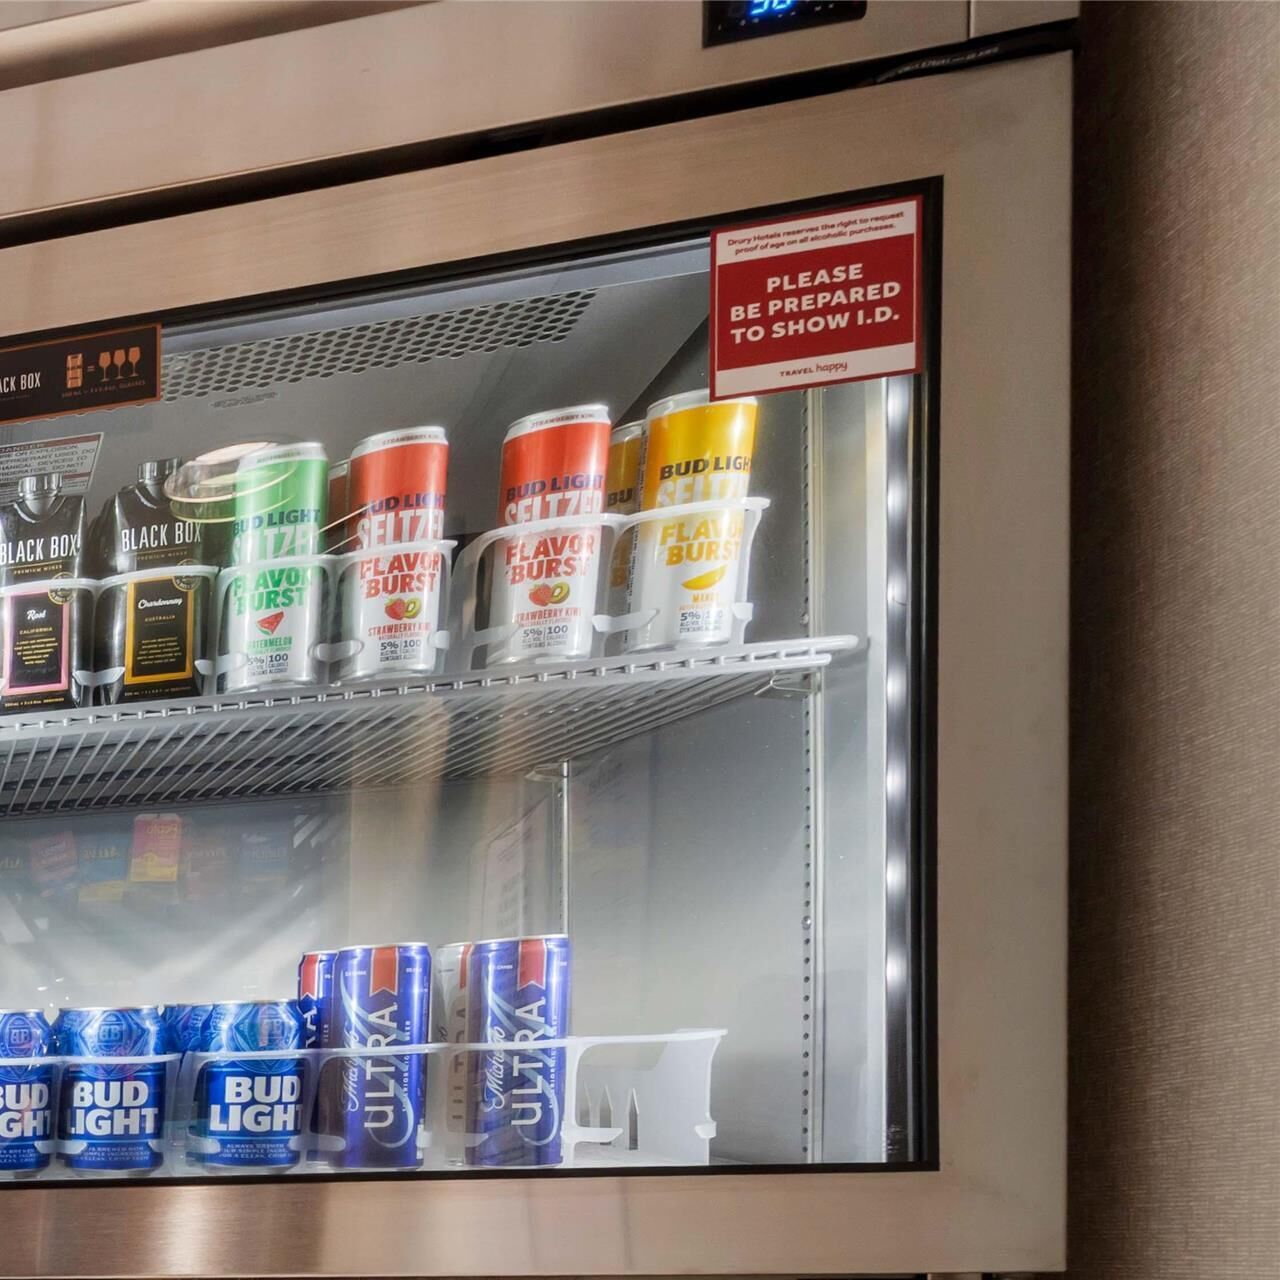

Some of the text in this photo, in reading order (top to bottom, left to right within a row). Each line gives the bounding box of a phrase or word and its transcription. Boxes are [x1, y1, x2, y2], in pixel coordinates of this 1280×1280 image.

[728, 211, 905, 248] Drury Hotels reserves the right to request
[734, 223, 896, 256] proof of age on all alcoholic purchases.
[766, 263, 864, 293] PLEASE
[730, 281, 902, 322] BE PREPARED
[730, 306, 900, 344] TO SHOW I.D.
[20, 371, 42, 391] BOX
[779, 361, 848, 378] TRAVEL happy
[659, 459, 708, 481] BUD
[507, 474, 604, 500] BUD LIGHT
[267, 509, 321, 527] LIGHT
[0, 533, 78, 566] BLACK BOX
[121, 521, 202, 552] BLACK BOX
[506, 534, 595, 566] FLAVOR
[665, 541, 740, 566] BURST
[13, 566, 42, 575] PREMIUM
[360, 552, 443, 579] FLAVOR
[510, 556, 589, 585] BURST
[365, 573, 437, 599] BURST
[137, 597, 183, 610] Chardonnay
[19, 626, 53, 635] CALIFORNIA
[144, 614, 176, 623] AUSTRALIA
[368, 623, 416, 637] STRAWBERRY
[547, 624, 569, 635] 100
[522, 626, 543, 638] 5%
[268, 653, 289, 663] 100
[380, 640, 400, 651] 5%
[364, 1003, 398, 1129] ULTRA
[511, 996, 547, 1126] ULTRA
[72, 1080, 149, 1110] BUD
[224, 1075, 301, 1104] BUD
[66, 1106, 160, 1137] LIGHT
